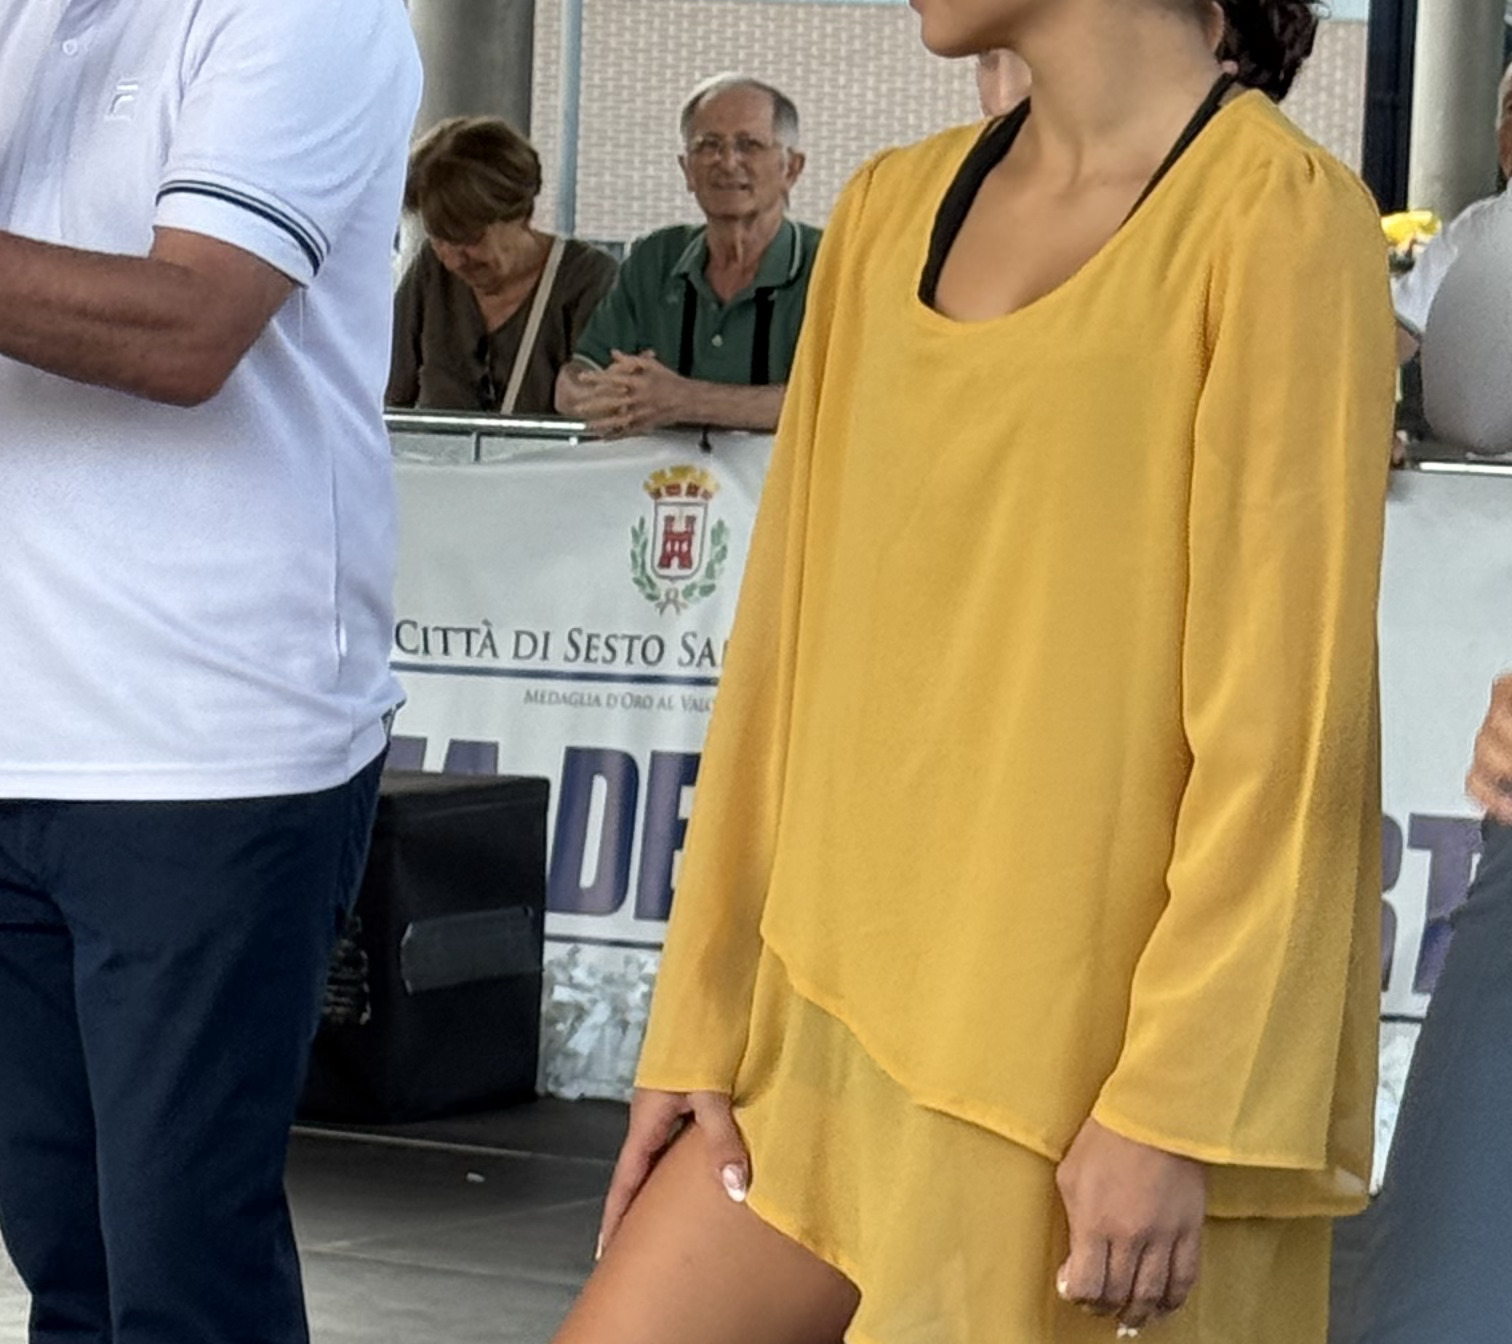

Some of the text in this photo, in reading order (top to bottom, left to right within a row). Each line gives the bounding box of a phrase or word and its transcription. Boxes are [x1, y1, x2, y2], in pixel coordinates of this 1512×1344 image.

[394, 618, 725, 668] CITTÀ DI SESTO SA
[522, 688, 602, 709] MEDAGLIA
[545, 745, 702, 922] DE
